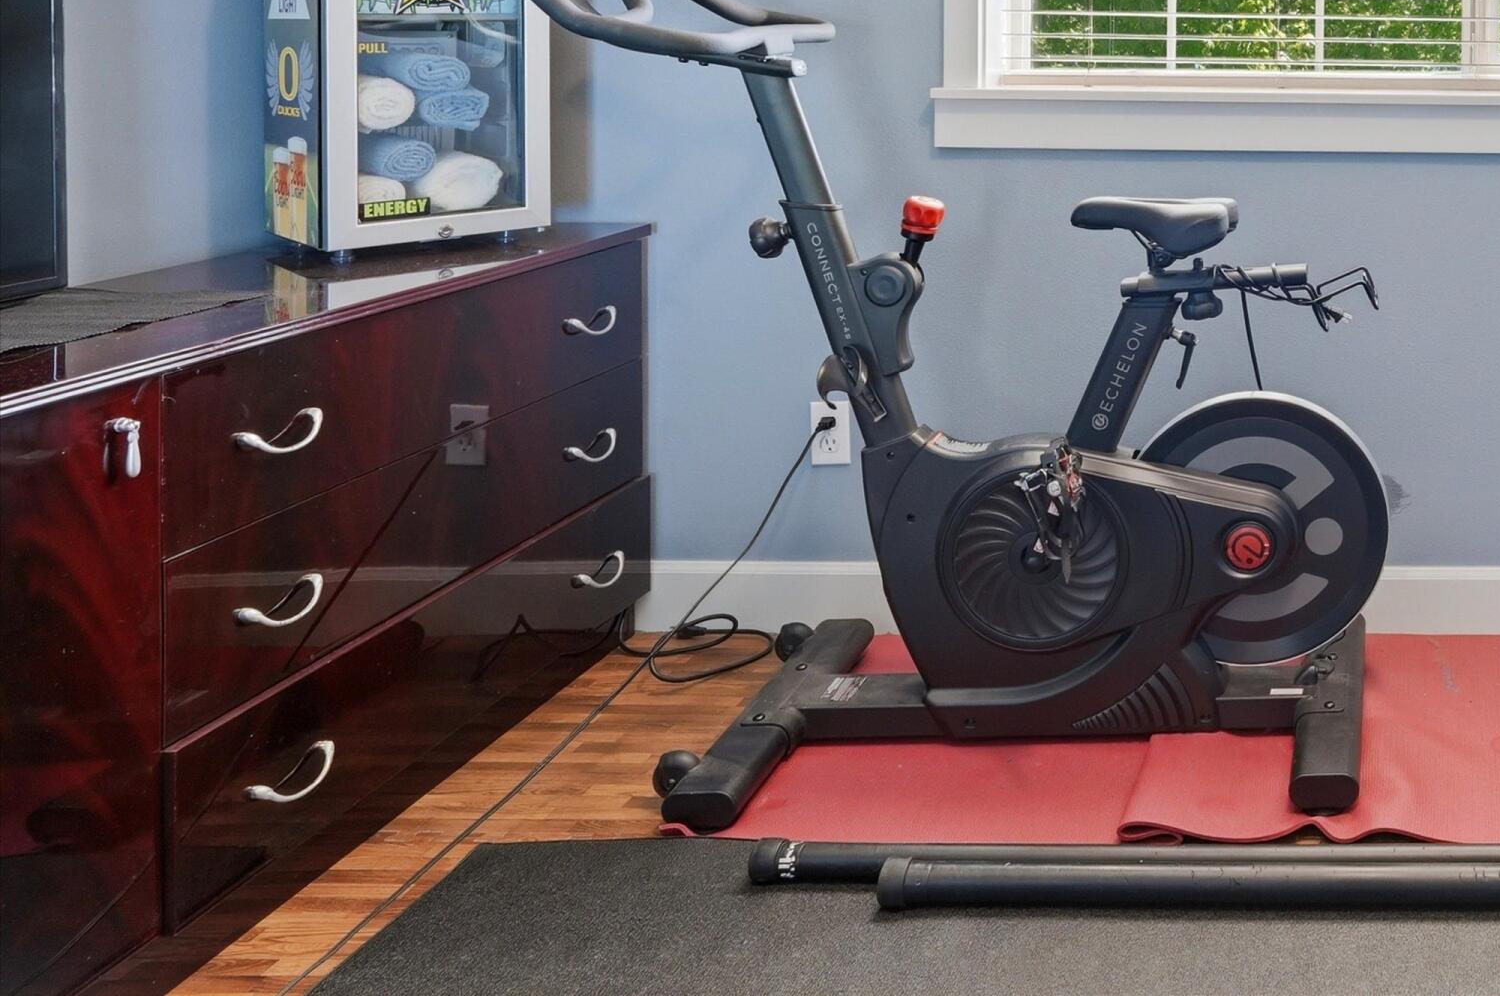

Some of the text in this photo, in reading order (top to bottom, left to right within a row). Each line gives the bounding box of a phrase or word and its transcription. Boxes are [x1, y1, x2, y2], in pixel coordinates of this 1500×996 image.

[358, 43, 388, 54] PULL
[364, 198, 429, 218] ENERGY
[807, 222, 842, 304] CONNECT
[1099, 322, 1148, 412] ECHELON
